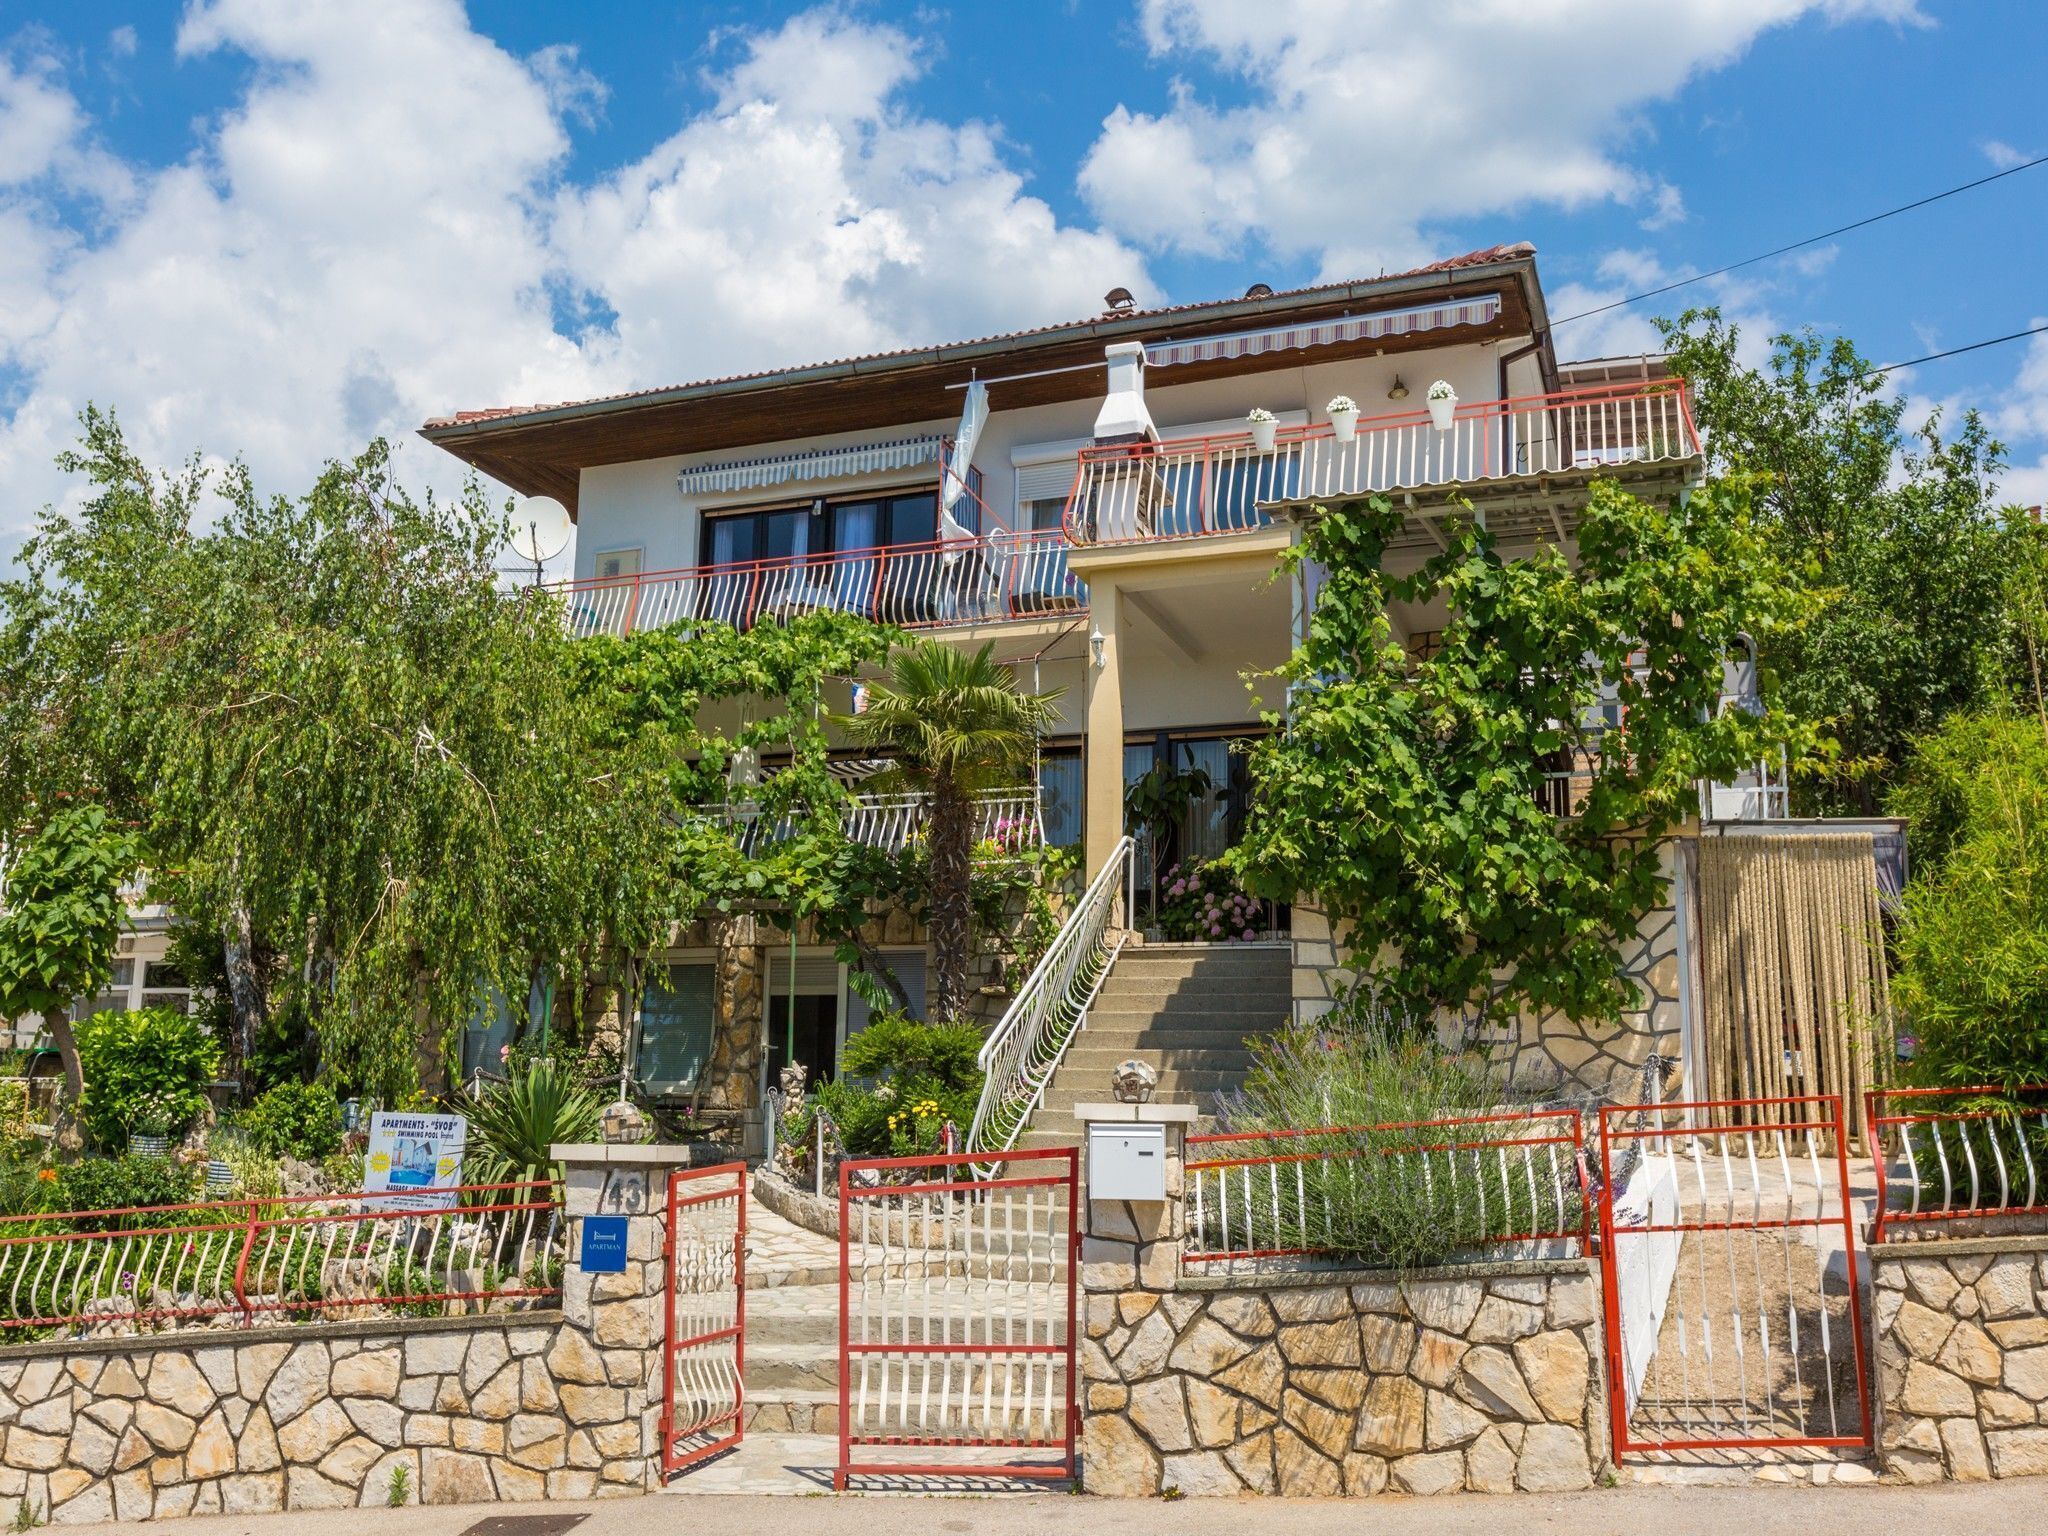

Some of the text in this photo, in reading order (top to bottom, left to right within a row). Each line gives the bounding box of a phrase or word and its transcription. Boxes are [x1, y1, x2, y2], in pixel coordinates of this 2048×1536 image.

[381, 1119, 425, 1129] APARTMENTS
[397, 1130, 439, 1139] SWIMMING POOL
[607, 1177, 641, 1213] 43
